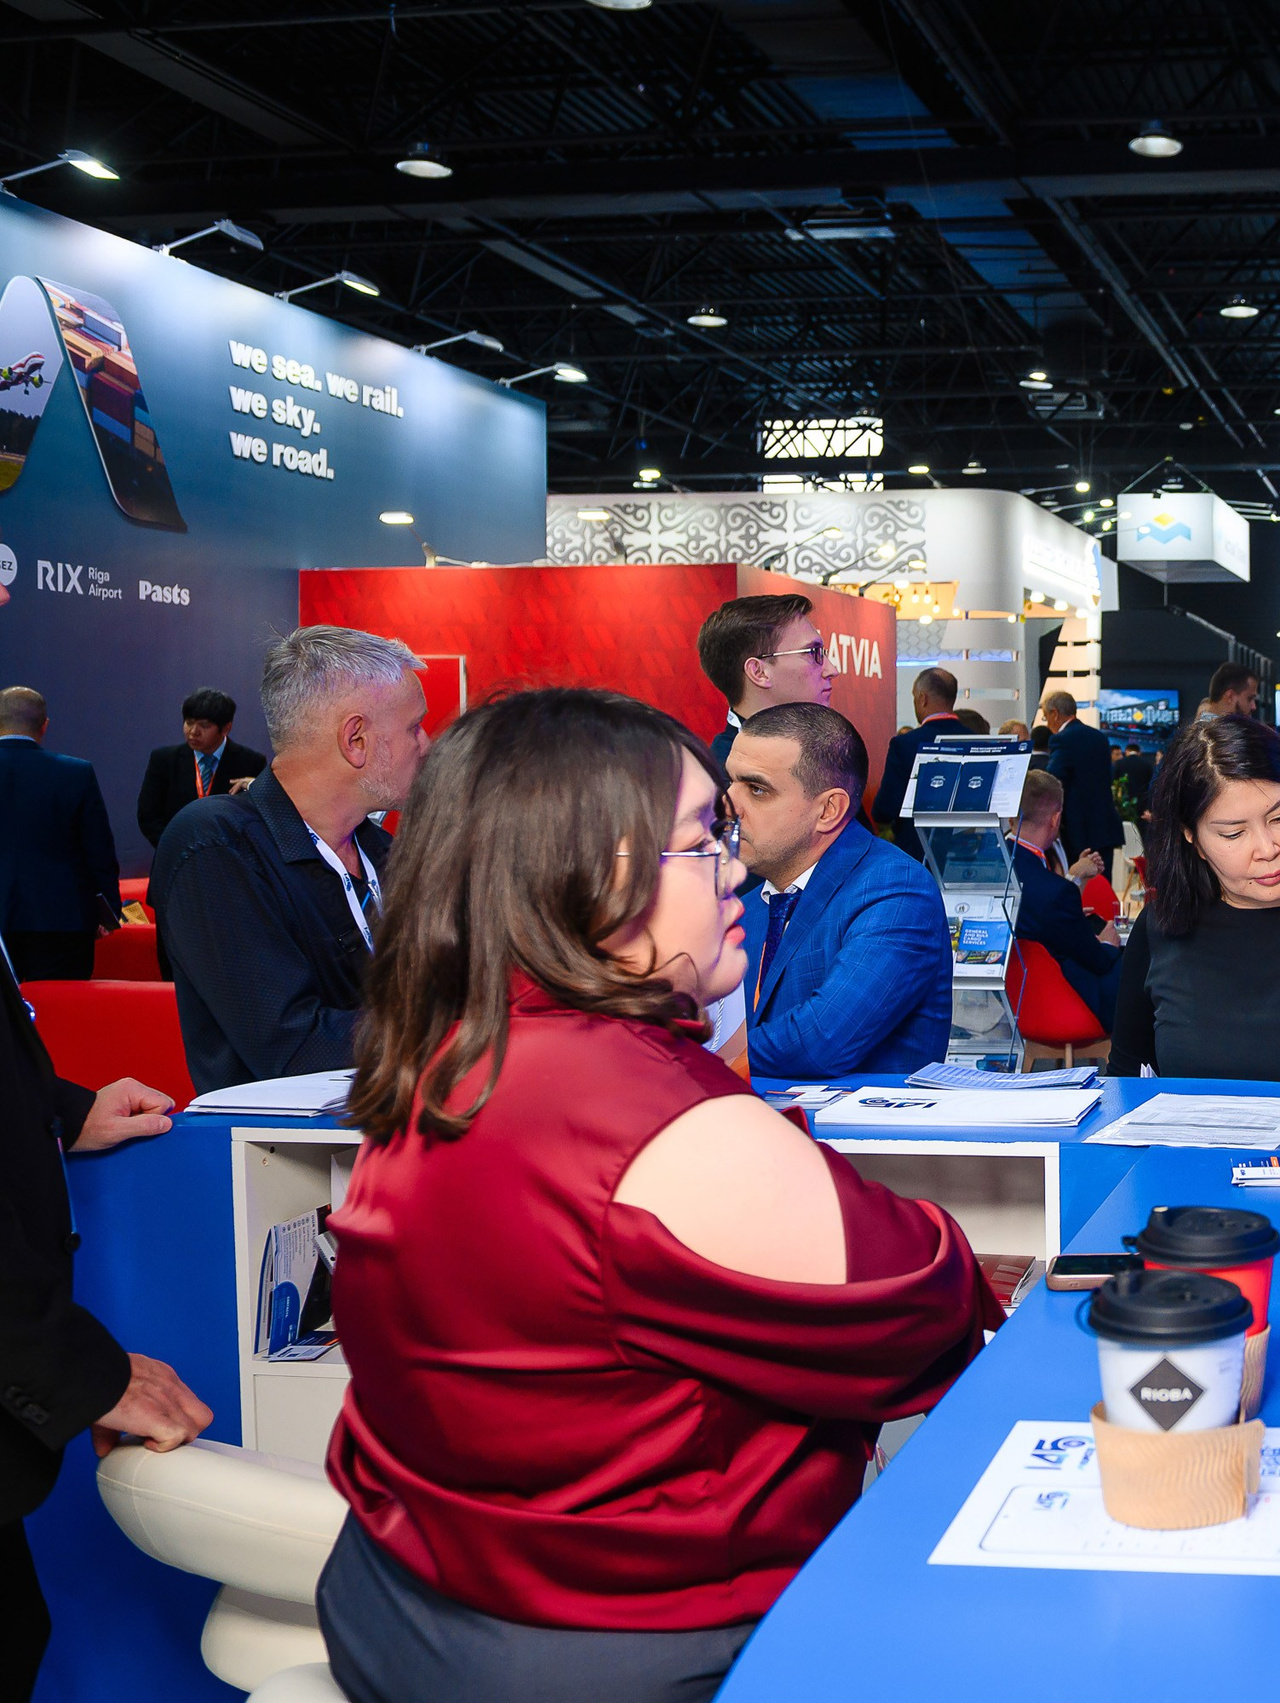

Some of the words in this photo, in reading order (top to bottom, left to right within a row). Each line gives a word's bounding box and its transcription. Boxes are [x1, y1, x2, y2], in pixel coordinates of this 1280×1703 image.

[228, 339, 268, 374] we
[272, 355, 323, 392] sea.
[325, 371, 359, 403] we
[362, 384, 404, 418] rail.
[229, 385, 268, 419] we
[271, 395, 321, 437] sky.
[229, 431, 268, 463] we
[272, 442, 334, 480] road.
[0, 560, 13, 571] EZ
[37, 559, 84, 595] RIX
[88, 567, 110, 583] Riga
[88, 584, 122, 601] Airport
[138, 580, 190, 606] Pasts
[821, 631, 882, 679] ATVIA
[1140, 1386, 1193, 1402] RIOBA
